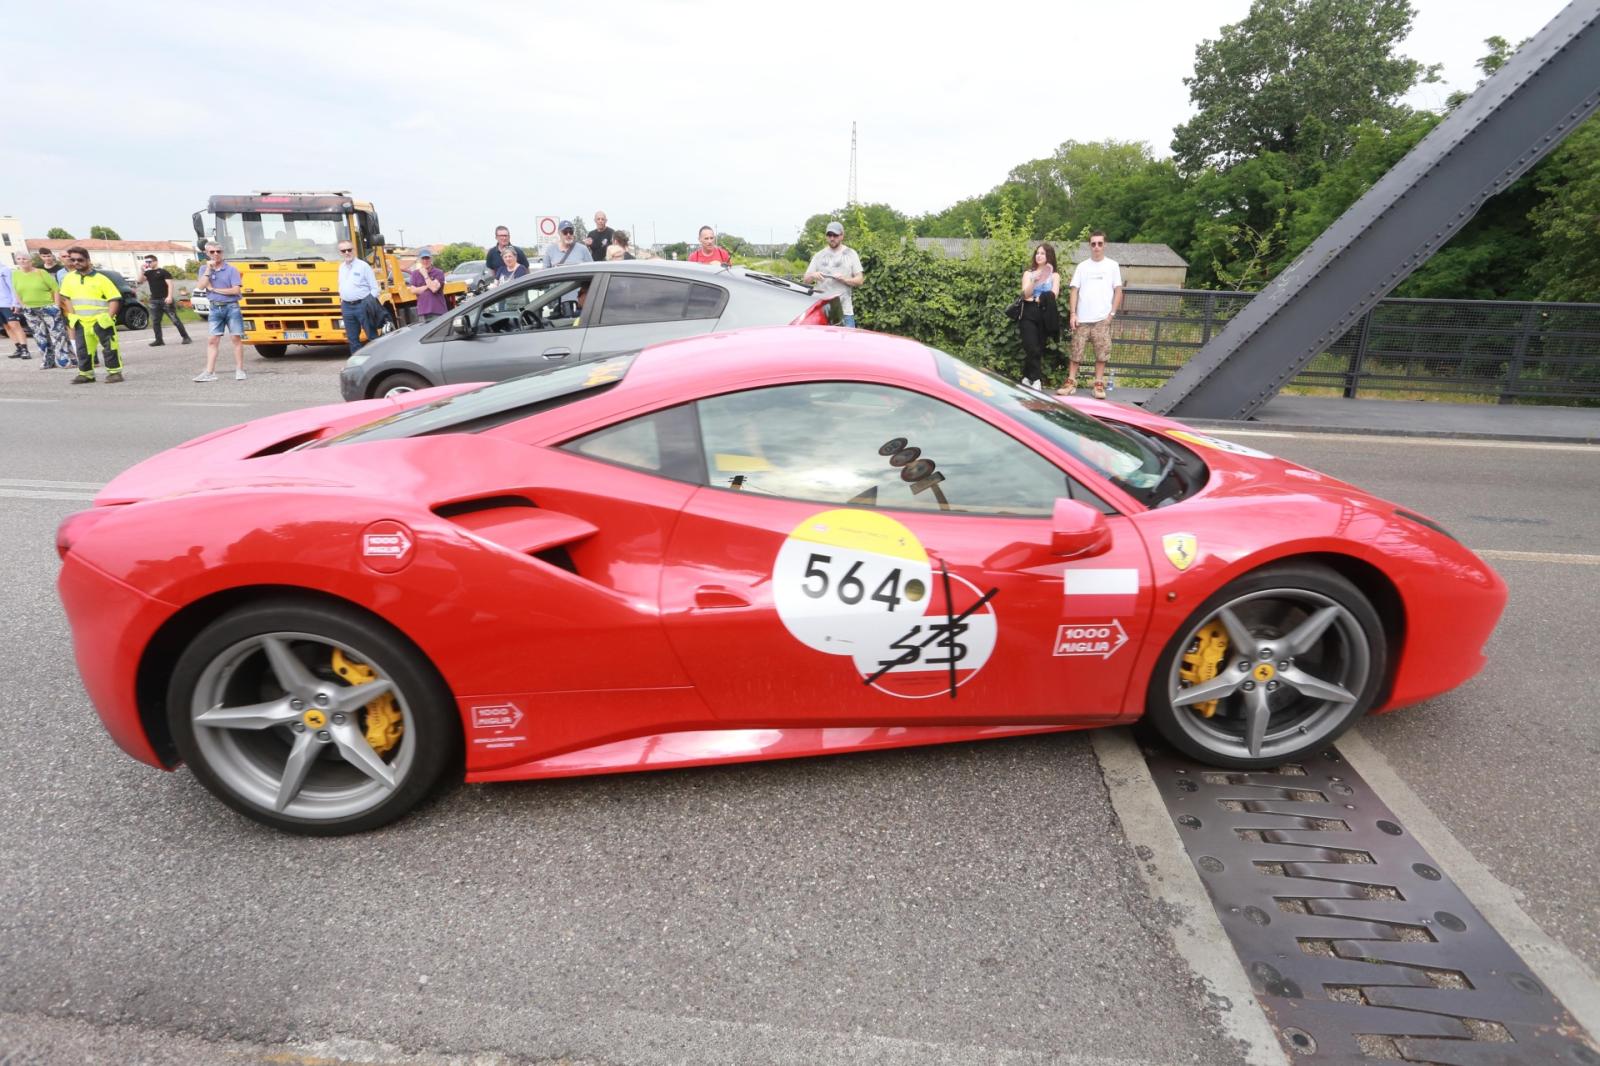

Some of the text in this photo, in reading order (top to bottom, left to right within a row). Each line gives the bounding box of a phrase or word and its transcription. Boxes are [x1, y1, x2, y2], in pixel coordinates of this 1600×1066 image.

[274, 297, 304, 305] IVECO
[801, 553, 902, 613] 564
[1065, 628, 1111, 639] 1000
[1060, 641, 1110, 653] MIGLIA
